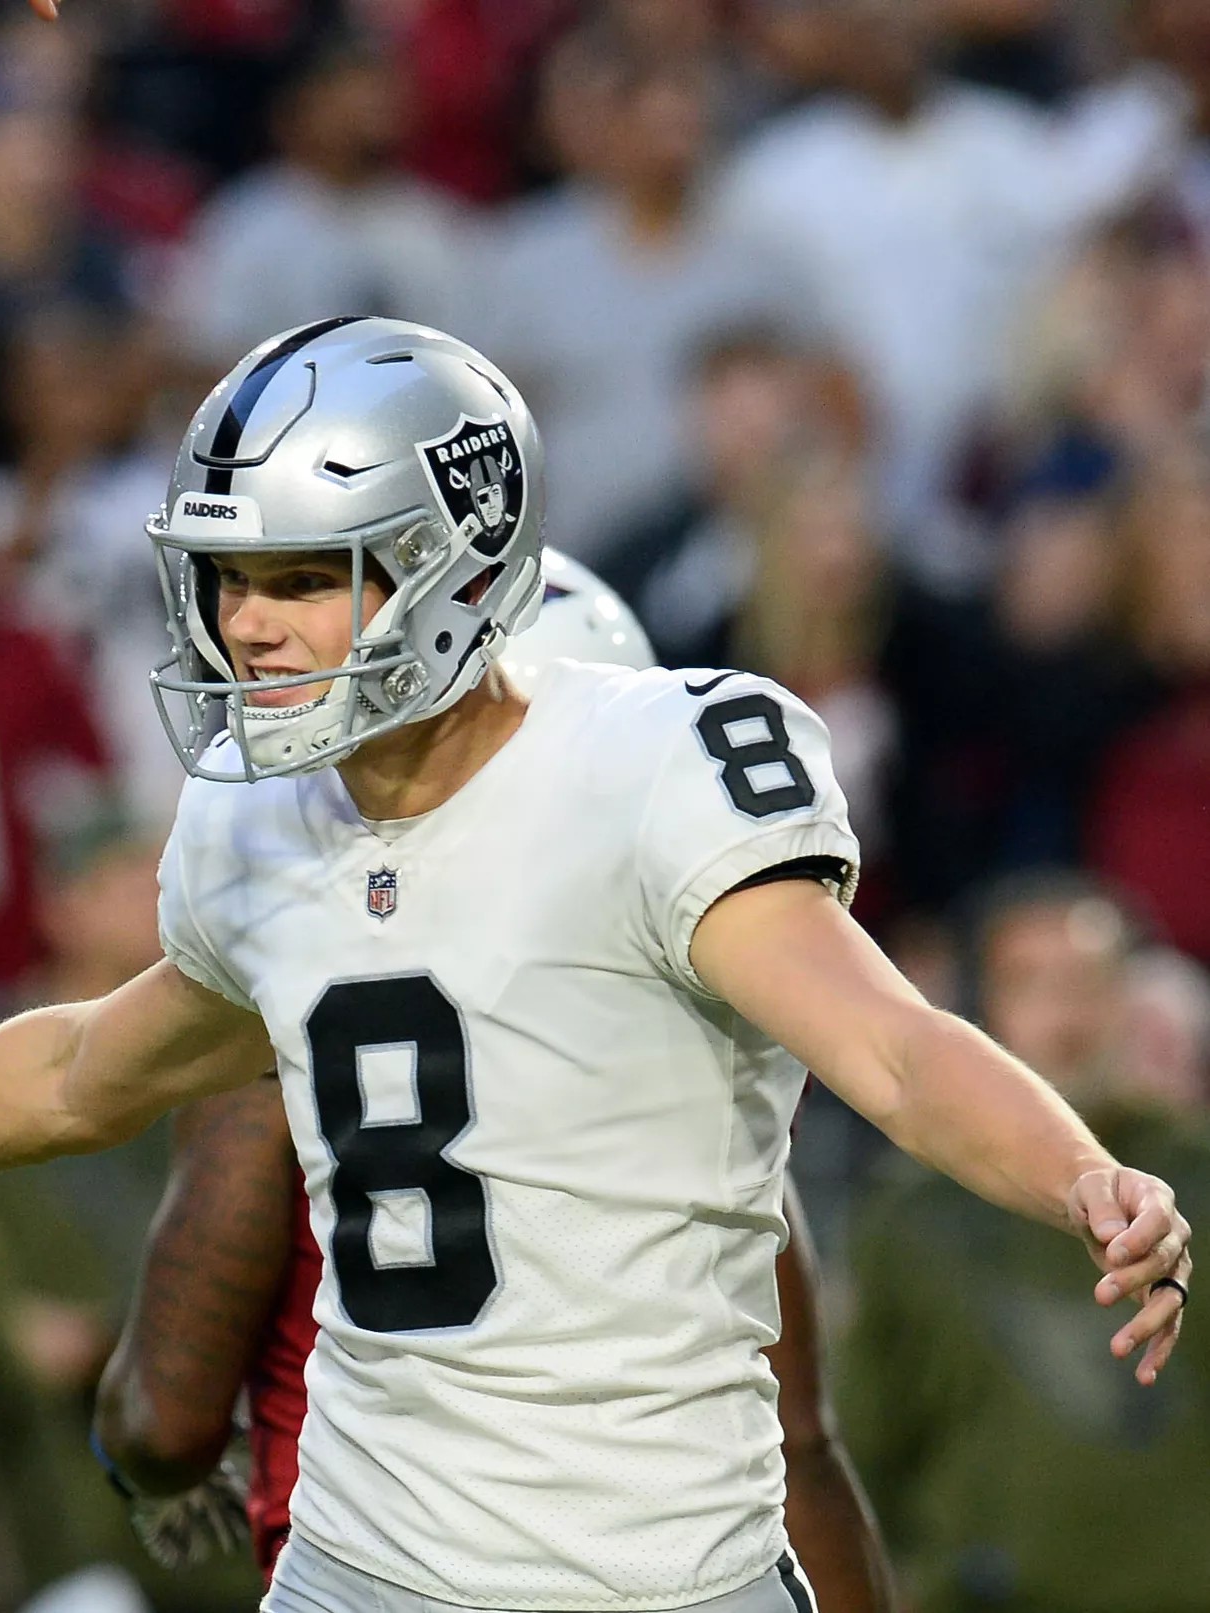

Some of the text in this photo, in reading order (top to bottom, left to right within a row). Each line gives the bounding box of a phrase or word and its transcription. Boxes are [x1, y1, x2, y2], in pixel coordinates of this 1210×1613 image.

[435, 425, 508, 464] RAIDERS
[183, 501, 238, 520] RAIDERS
[692, 692, 818, 823] 8
[370, 889, 394, 911] NFL
[304, 969, 504, 1334] 8
